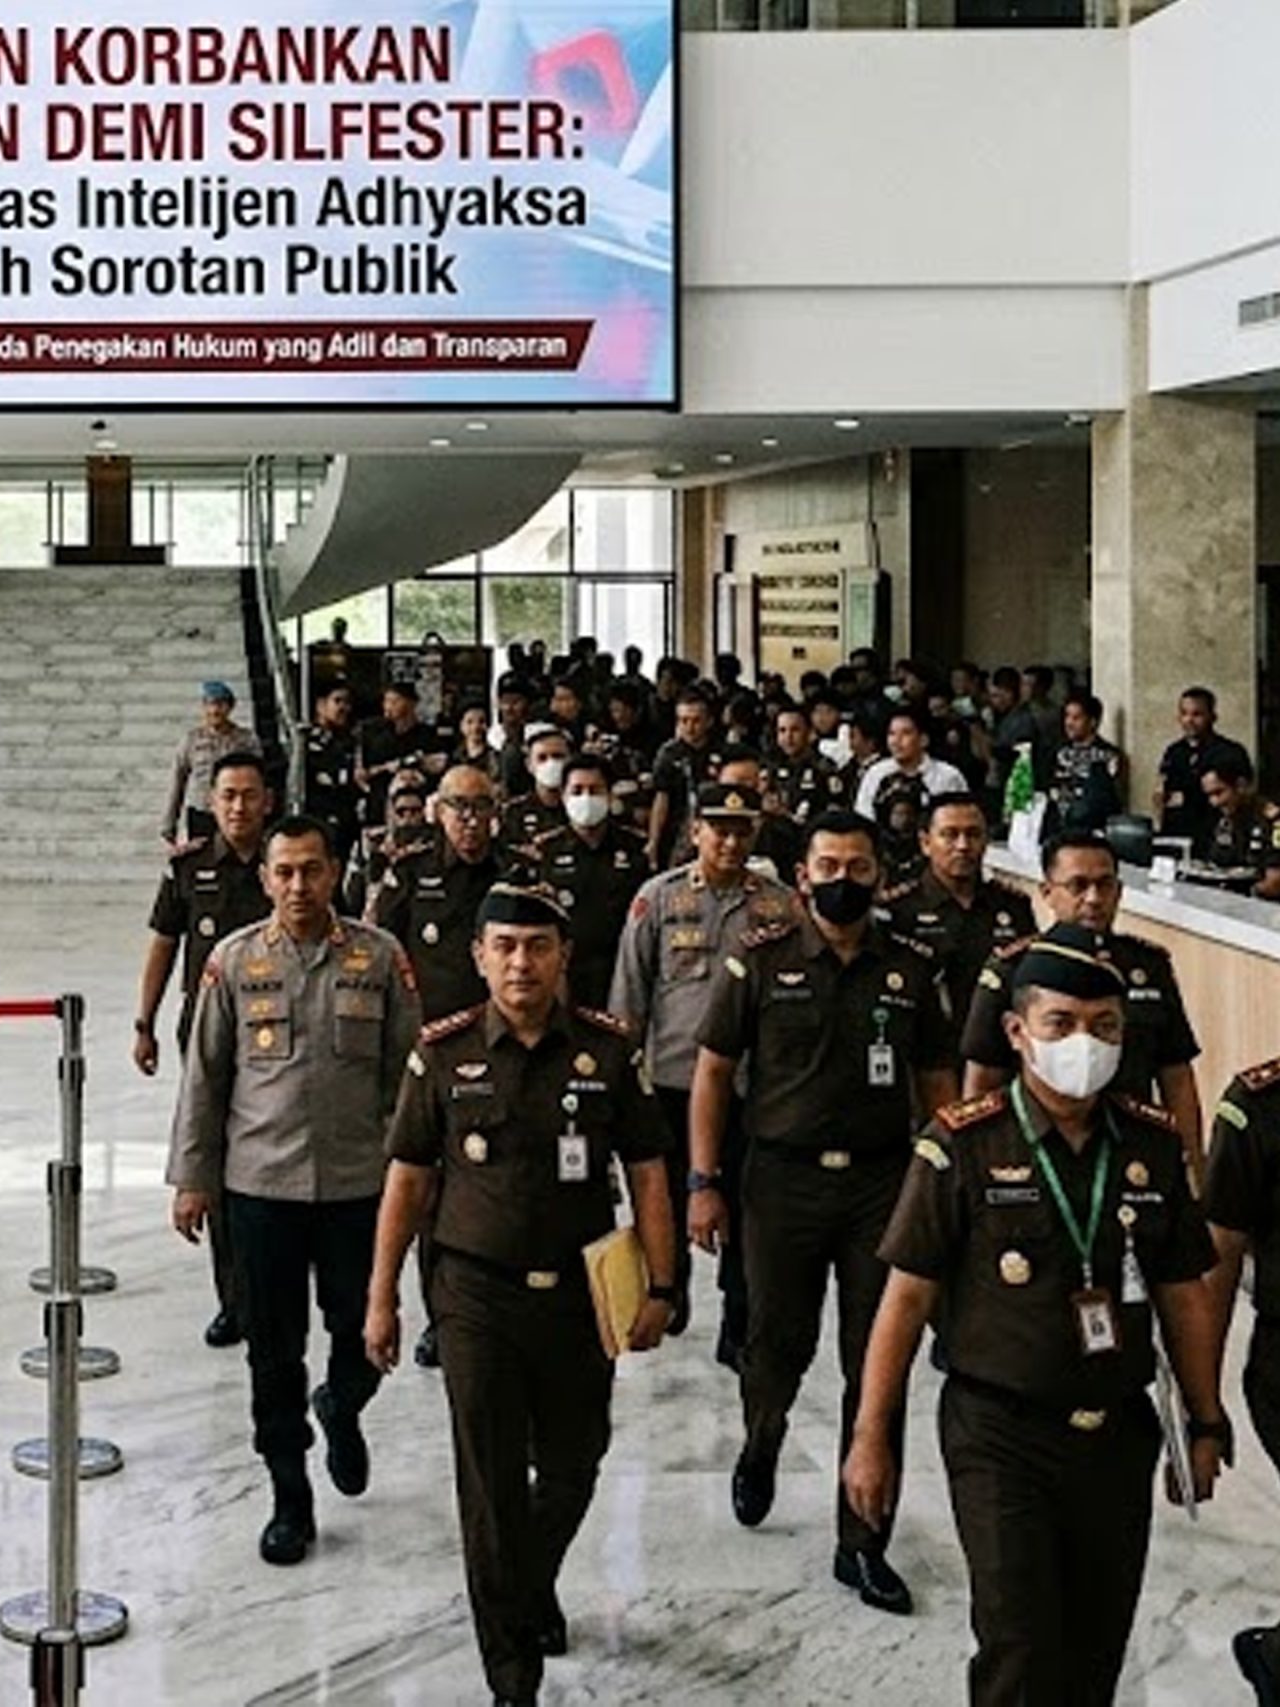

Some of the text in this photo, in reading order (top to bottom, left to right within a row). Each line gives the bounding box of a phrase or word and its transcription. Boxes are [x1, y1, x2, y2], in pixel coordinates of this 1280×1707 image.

[55, 26, 450, 86] KORBANKAN
[46, 102, 204, 162] DEMI
[227, 100, 584, 162] SILFESTER:
[79, 176, 296, 241] Intelijen
[316, 175, 587, 241] Adhyaksa
[51, 244, 265, 297] Sorotan
[286, 243, 458, 295] Publik
[34, 333, 166, 364] Penegakan
[173, 333, 257, 359] Hukum
[263, 336, 323, 363] yang
[328, 331, 376, 358] Adil
[381, 332, 427, 358] dan
[431, 332, 568, 362] Transparan
